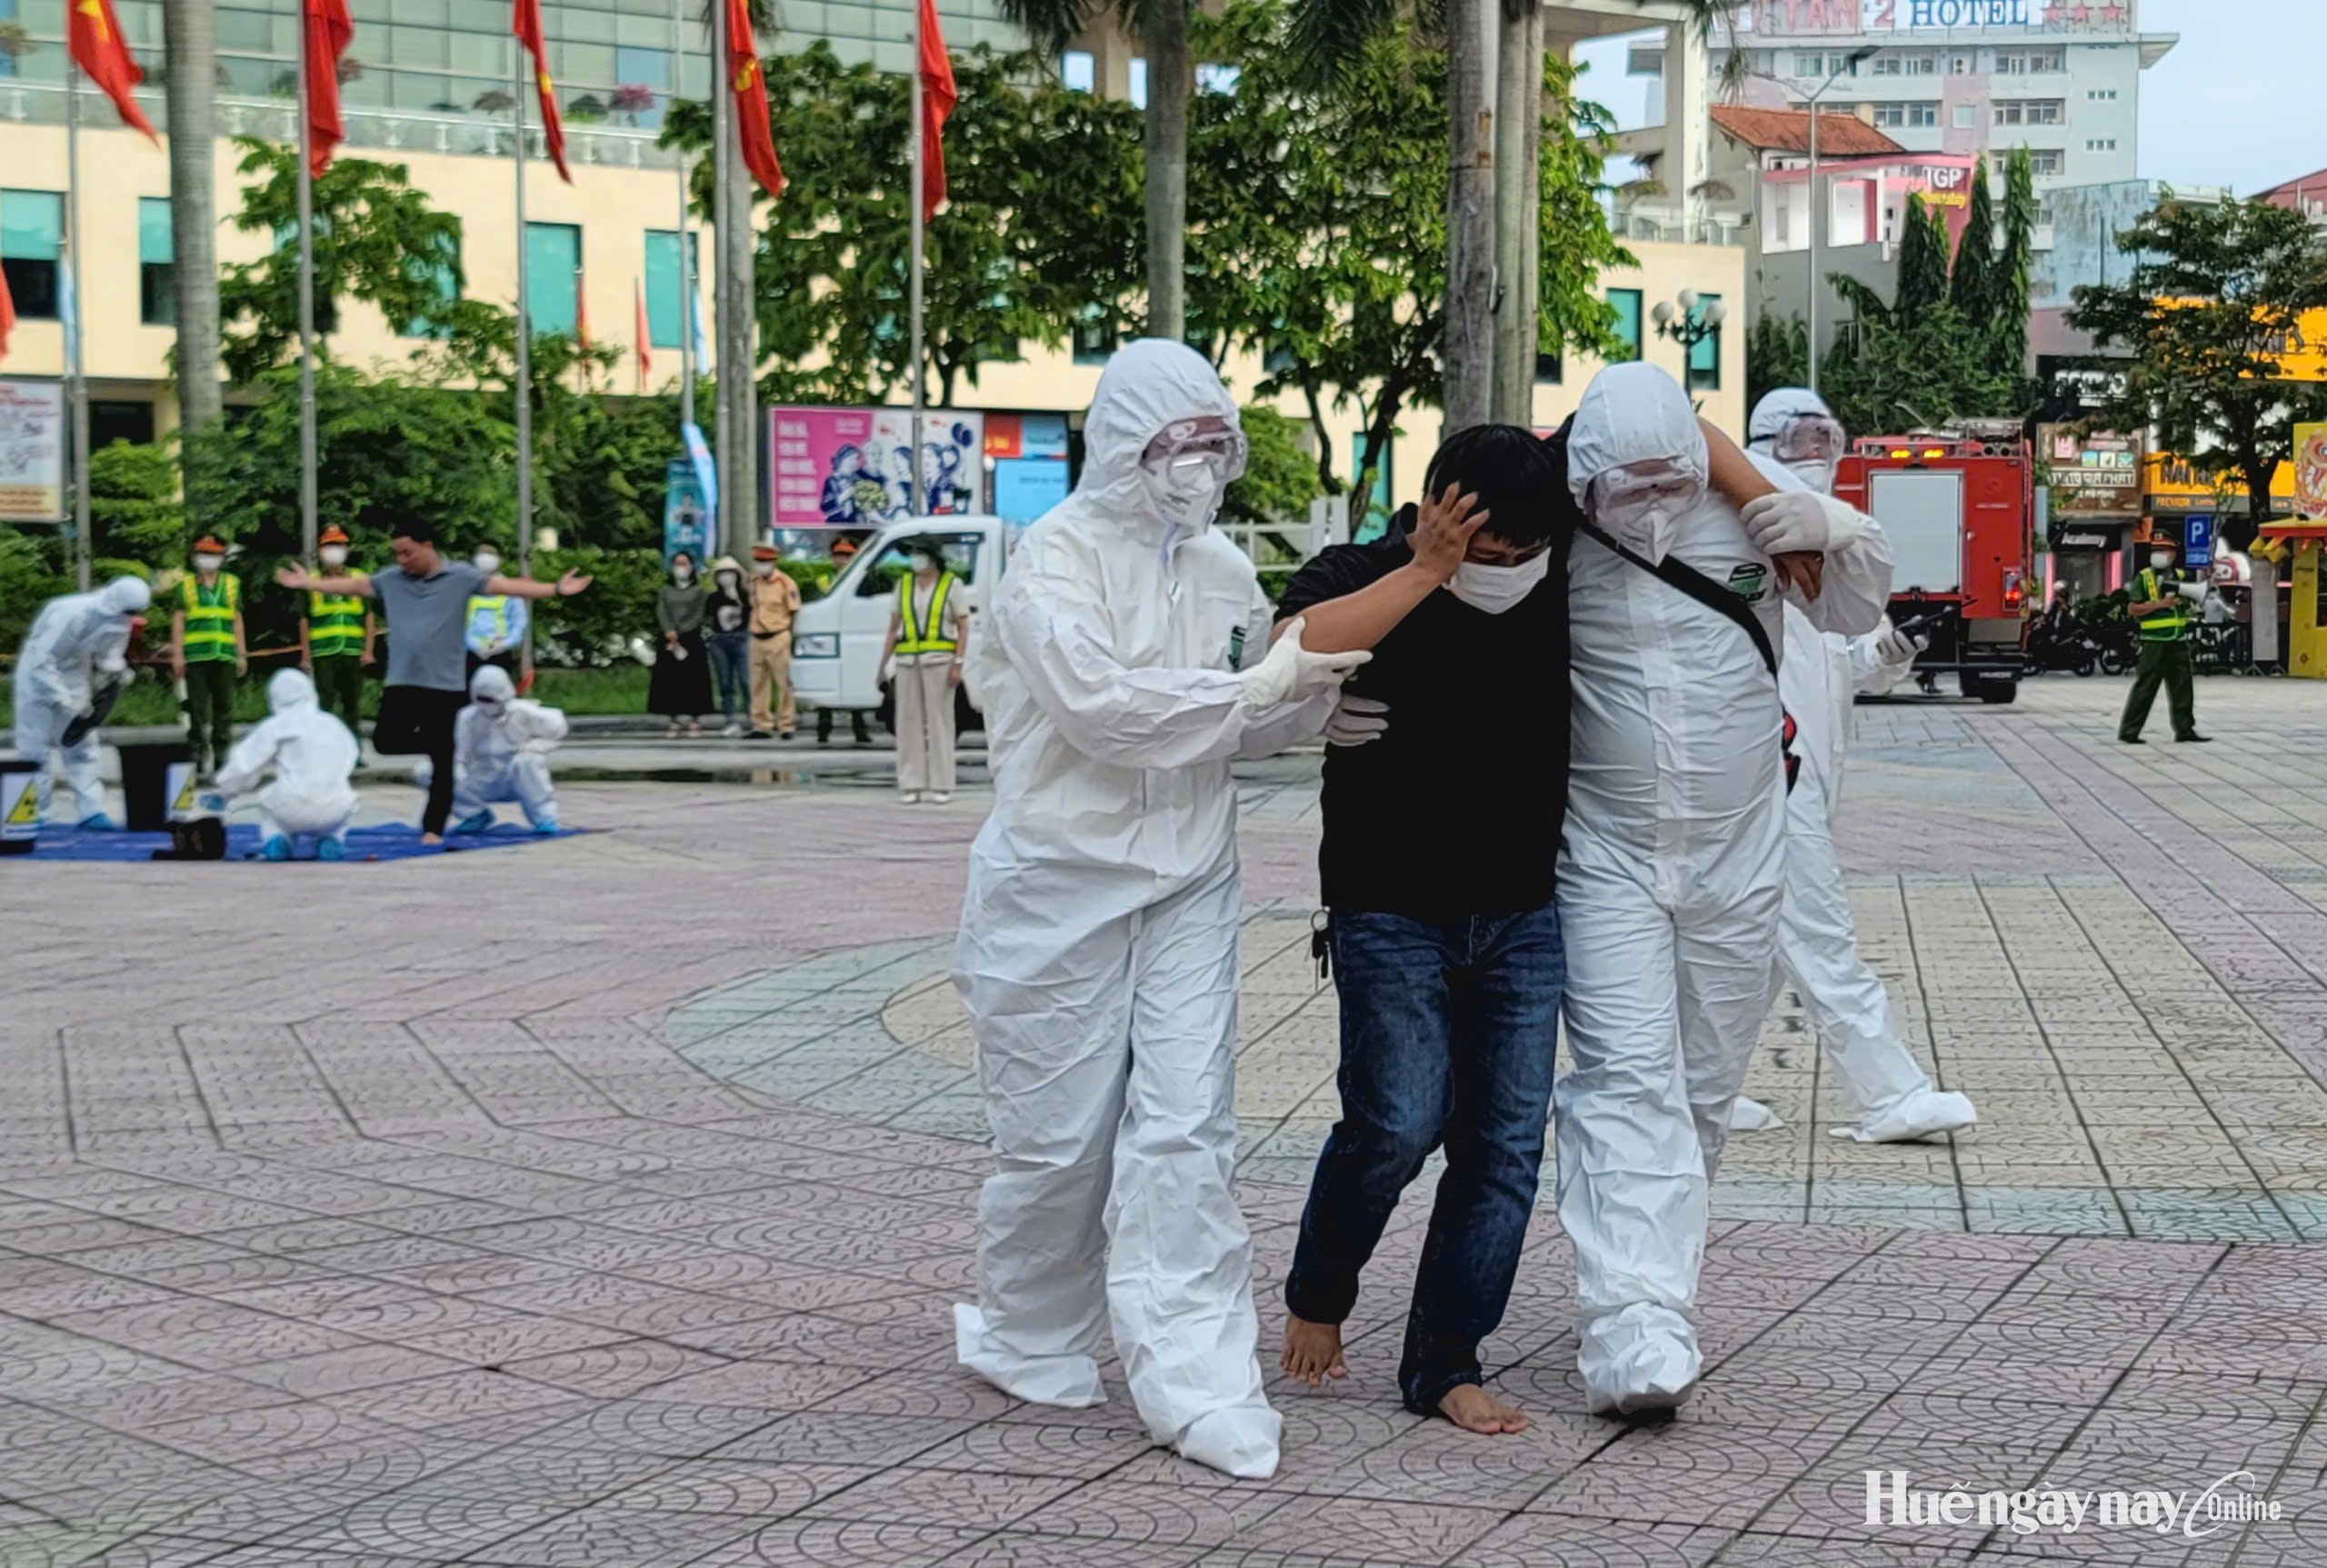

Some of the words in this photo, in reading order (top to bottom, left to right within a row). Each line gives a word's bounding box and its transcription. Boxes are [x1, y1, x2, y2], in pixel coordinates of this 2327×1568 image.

[1874, 0, 1895, 27] 2
[1909, 0, 2029, 26] HOTEL
[2061, 532, 2107, 547] Academy
[2192, 521, 2204, 544] P
